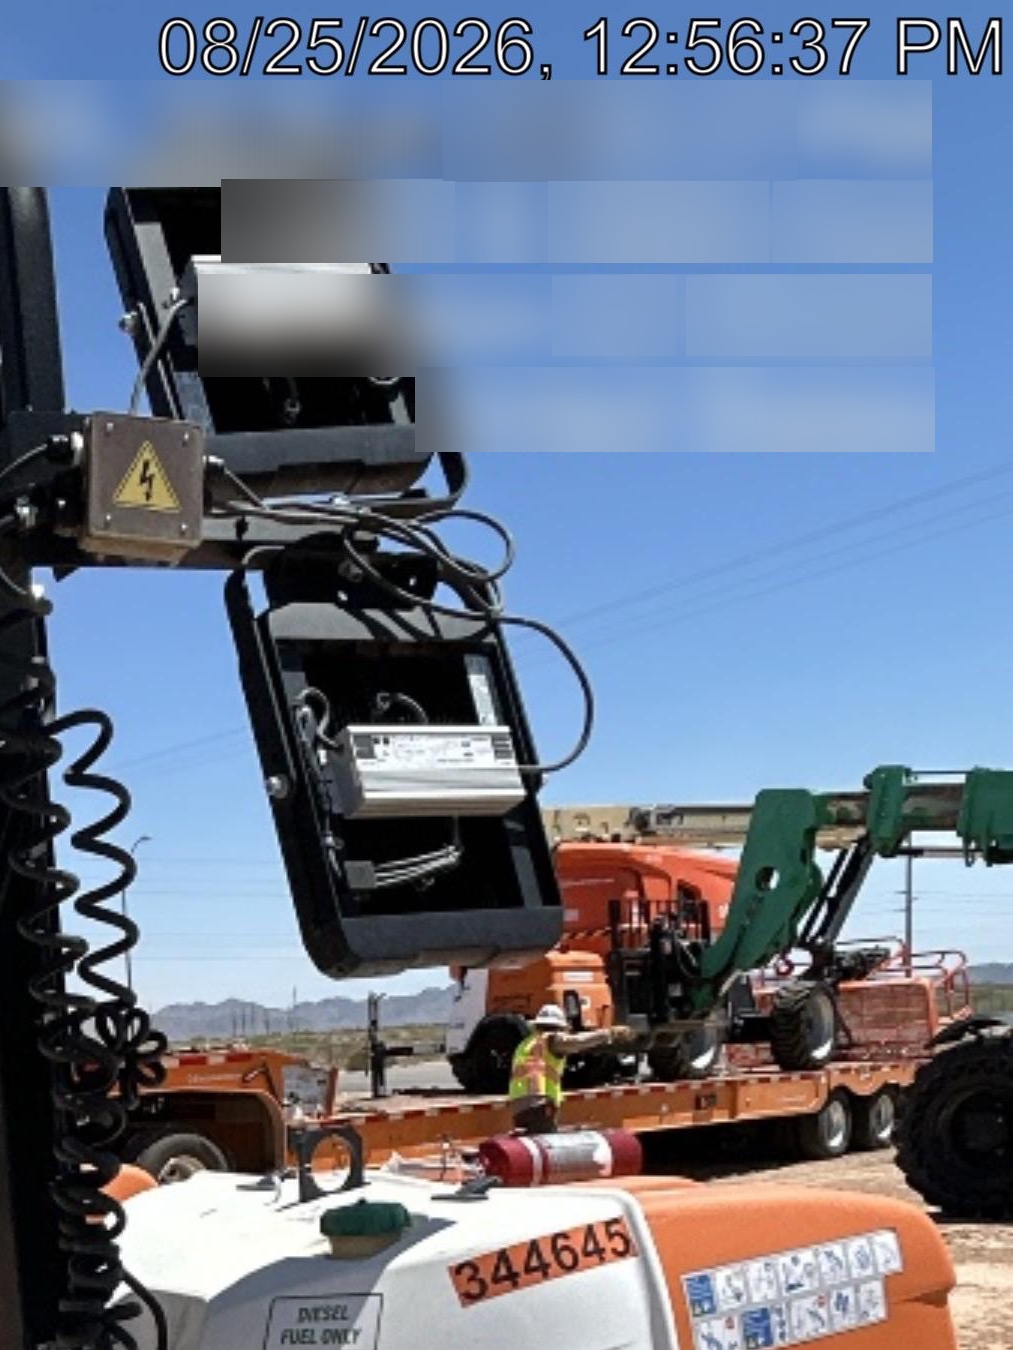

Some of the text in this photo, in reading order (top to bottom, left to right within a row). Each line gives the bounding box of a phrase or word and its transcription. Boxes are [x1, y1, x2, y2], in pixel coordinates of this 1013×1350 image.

[455, 1217, 631, 1301] 344645
[298, 1304, 349, 1323] DIESEL
[280, 1328, 362, 1345] FUEL ONLY
